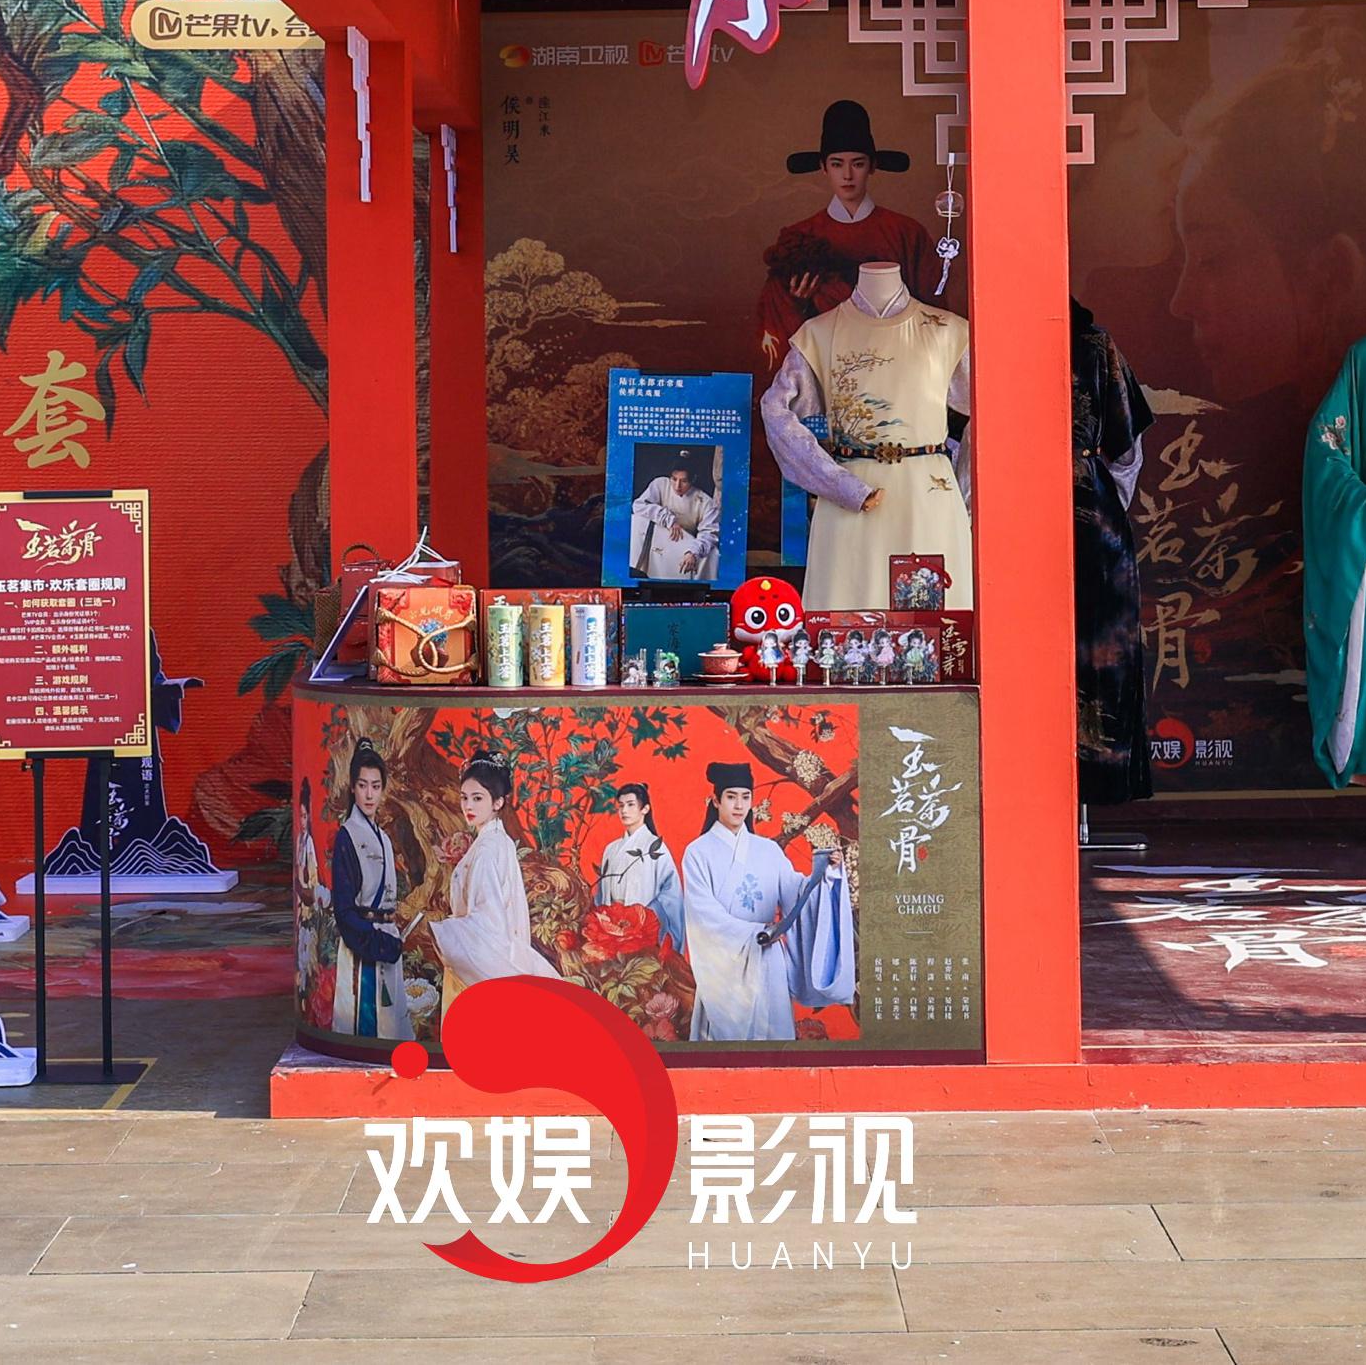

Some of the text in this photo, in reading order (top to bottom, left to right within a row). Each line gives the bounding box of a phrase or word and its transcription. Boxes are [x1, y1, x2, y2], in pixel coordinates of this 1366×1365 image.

[185, 14, 271, 37] 芒果tv
[285, 15, 317, 38] 会
[532, 45, 628, 66] 湖南卫视
[667, 44, 735, 64] 芒tv
[500, 94, 521, 165] 侯明昊
[895, 895, 944, 904] YUMING
[898, 905, 940, 915] CHAGU
